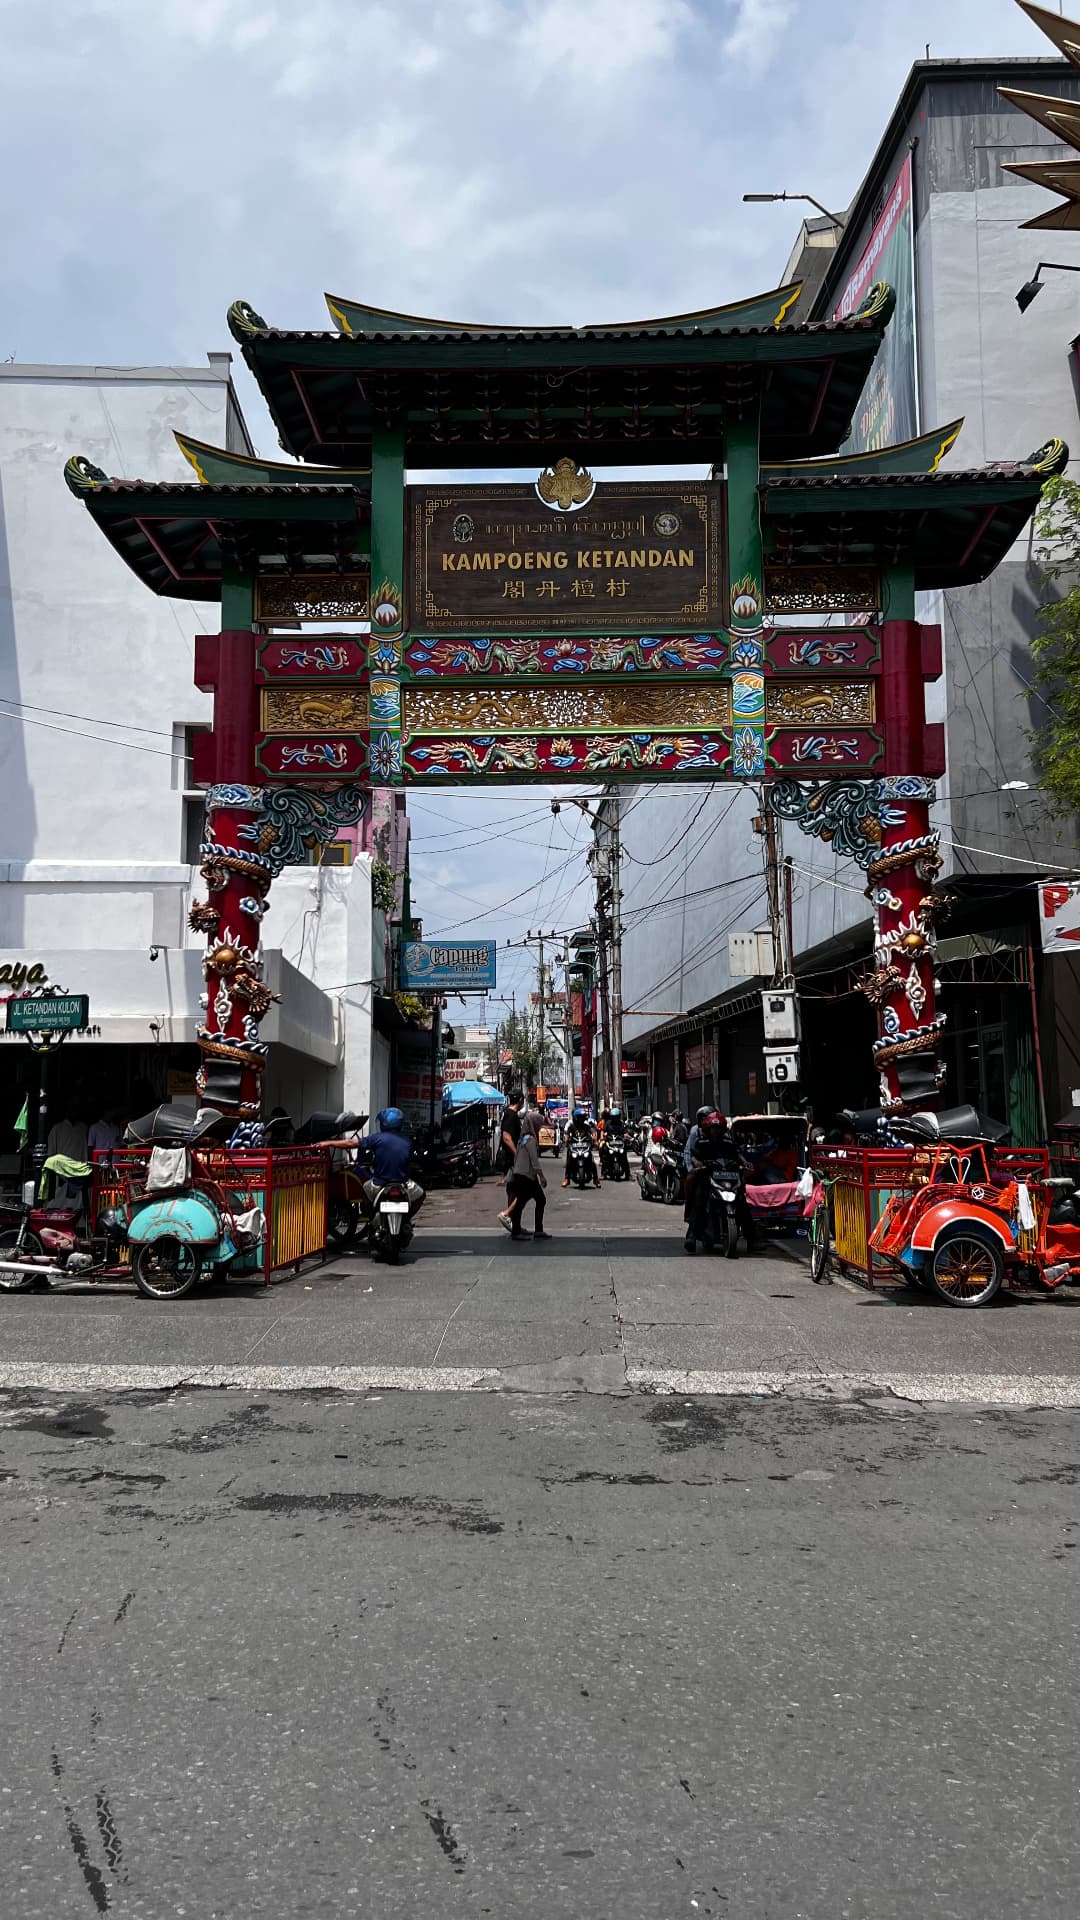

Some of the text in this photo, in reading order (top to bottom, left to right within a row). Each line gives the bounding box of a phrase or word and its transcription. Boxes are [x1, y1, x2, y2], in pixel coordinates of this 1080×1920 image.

[441, 549, 695, 571] KAMPOENG KETANDAN
[430, 945, 489, 967] Capung
[23, 1002, 57, 1015] KETANDAN
[58, 1001, 80, 1013] KULON
[444, 1070, 466, 1080] SOTO
